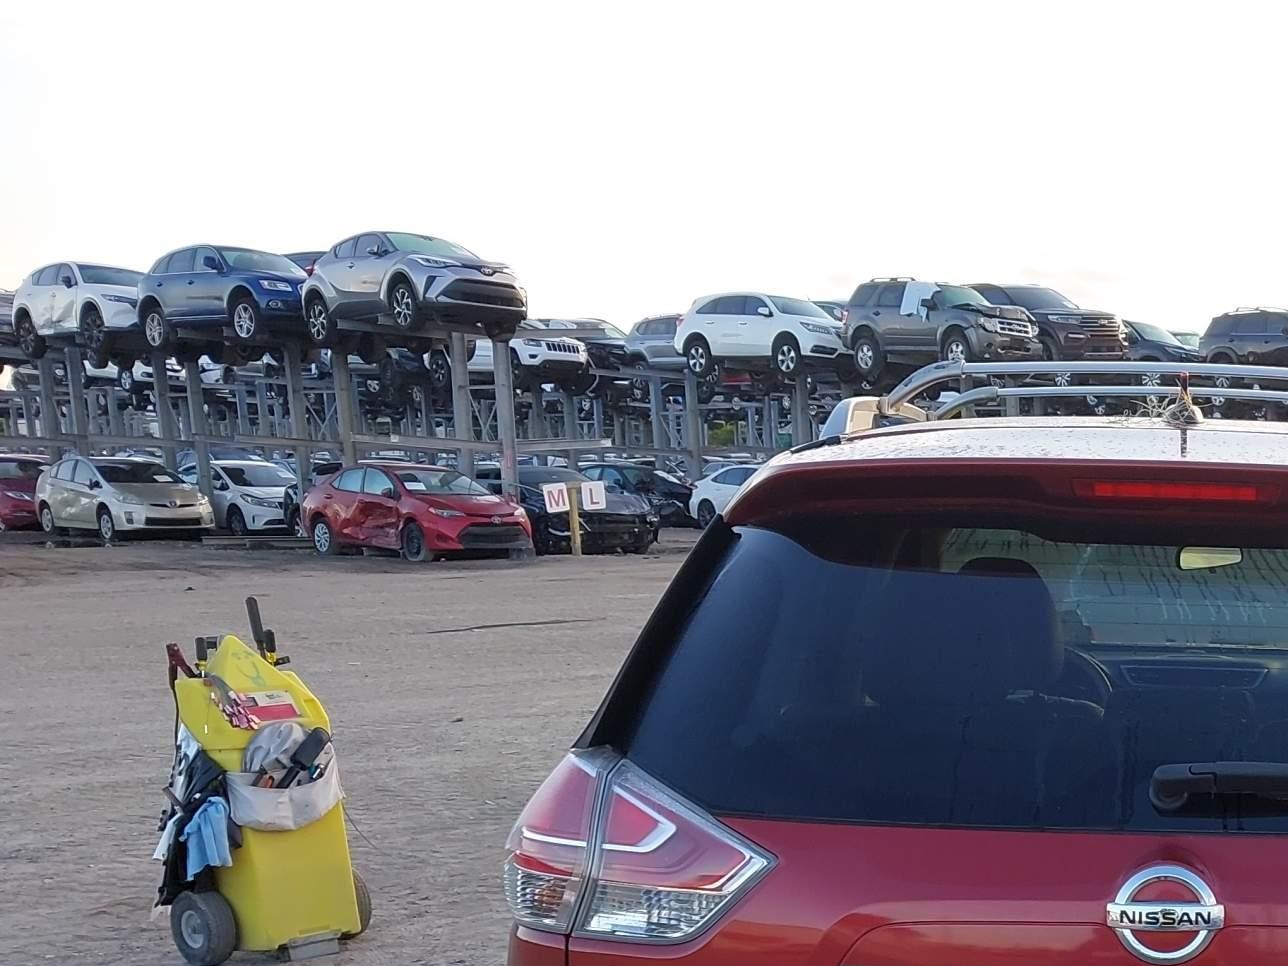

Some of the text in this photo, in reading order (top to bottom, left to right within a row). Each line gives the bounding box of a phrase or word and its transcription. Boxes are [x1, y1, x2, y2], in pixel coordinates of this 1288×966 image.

[547, 488, 566, 508] M
[588, 487, 600, 505] L
[1119, 909, 1212, 926] NISSAN
